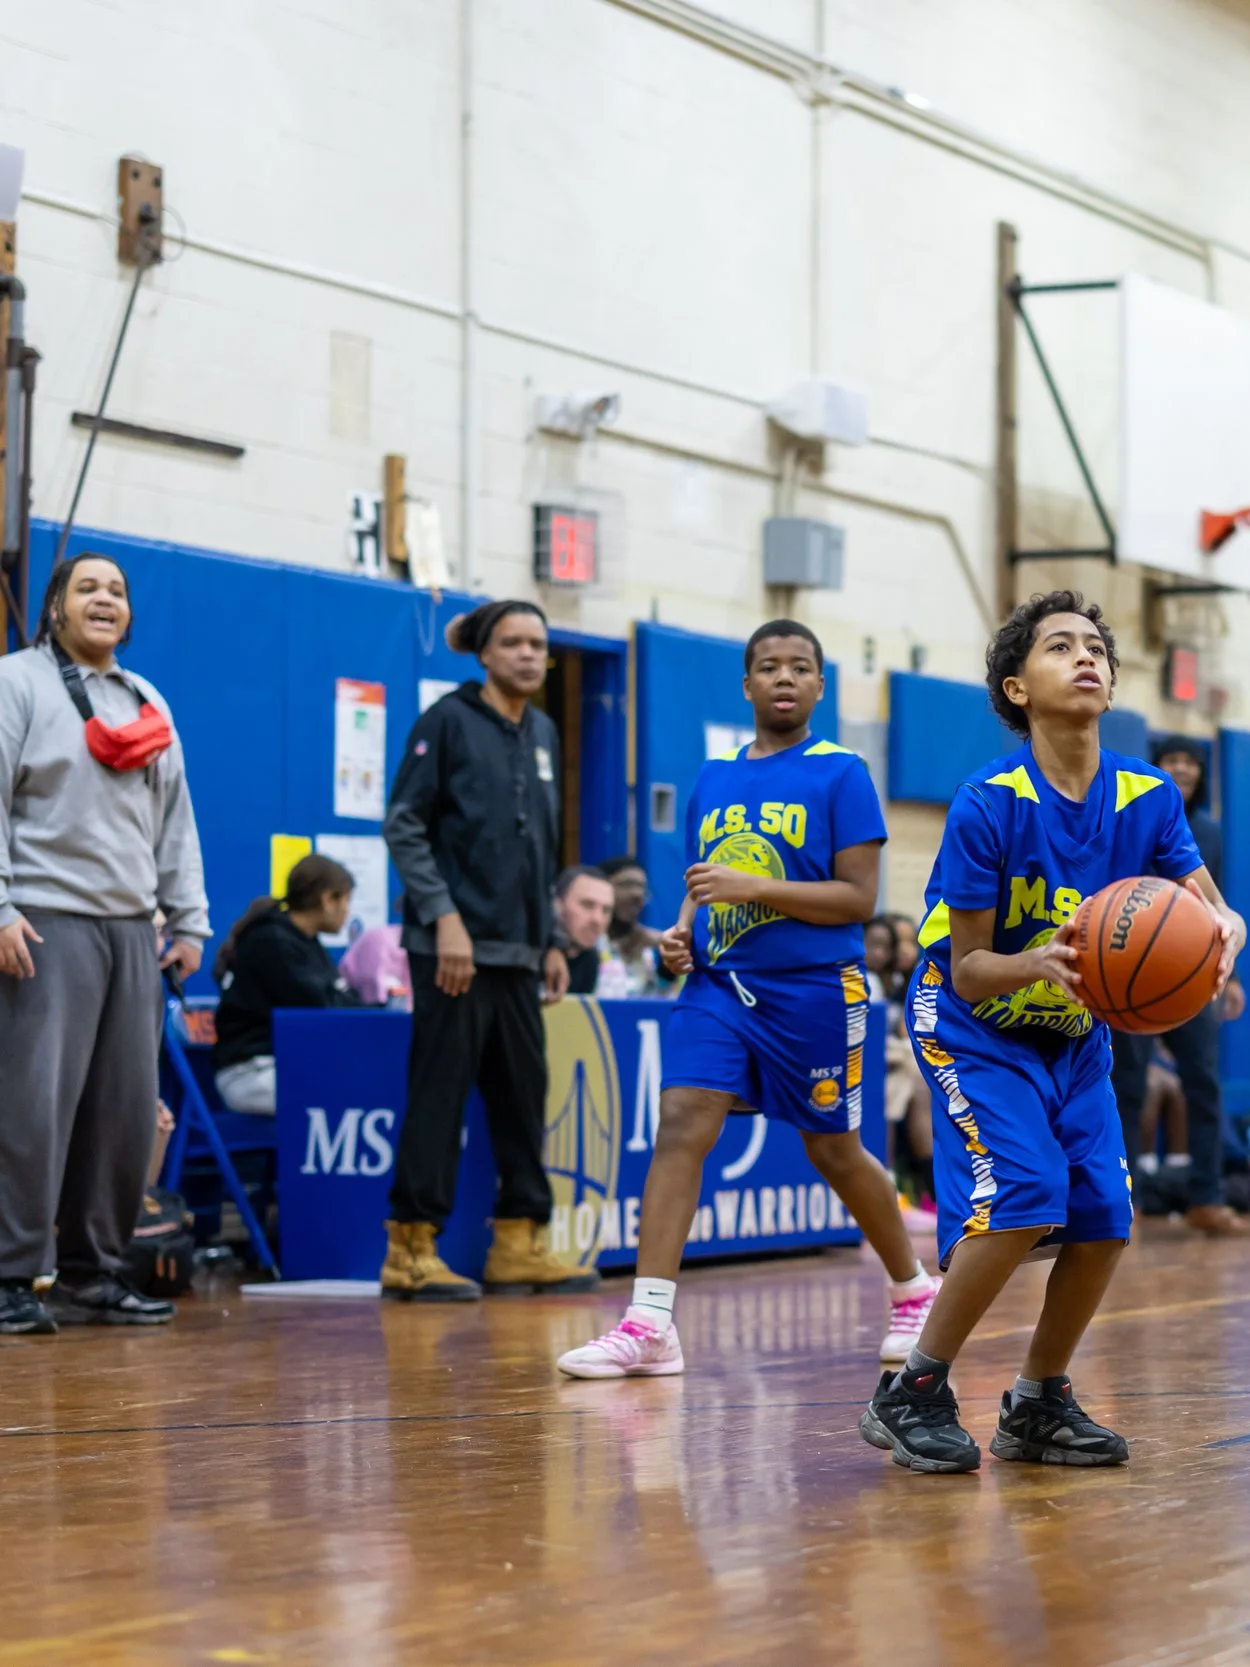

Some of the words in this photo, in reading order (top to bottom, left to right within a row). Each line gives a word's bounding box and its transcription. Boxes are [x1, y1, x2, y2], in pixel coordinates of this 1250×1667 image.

[759, 802, 807, 849] 50
[1109, 878, 1166, 952] Wilson
[810, 1067, 830, 1079] MS
[300, 1107, 395, 1177] MS
[714, 1182, 858, 1241] WARRIOR
